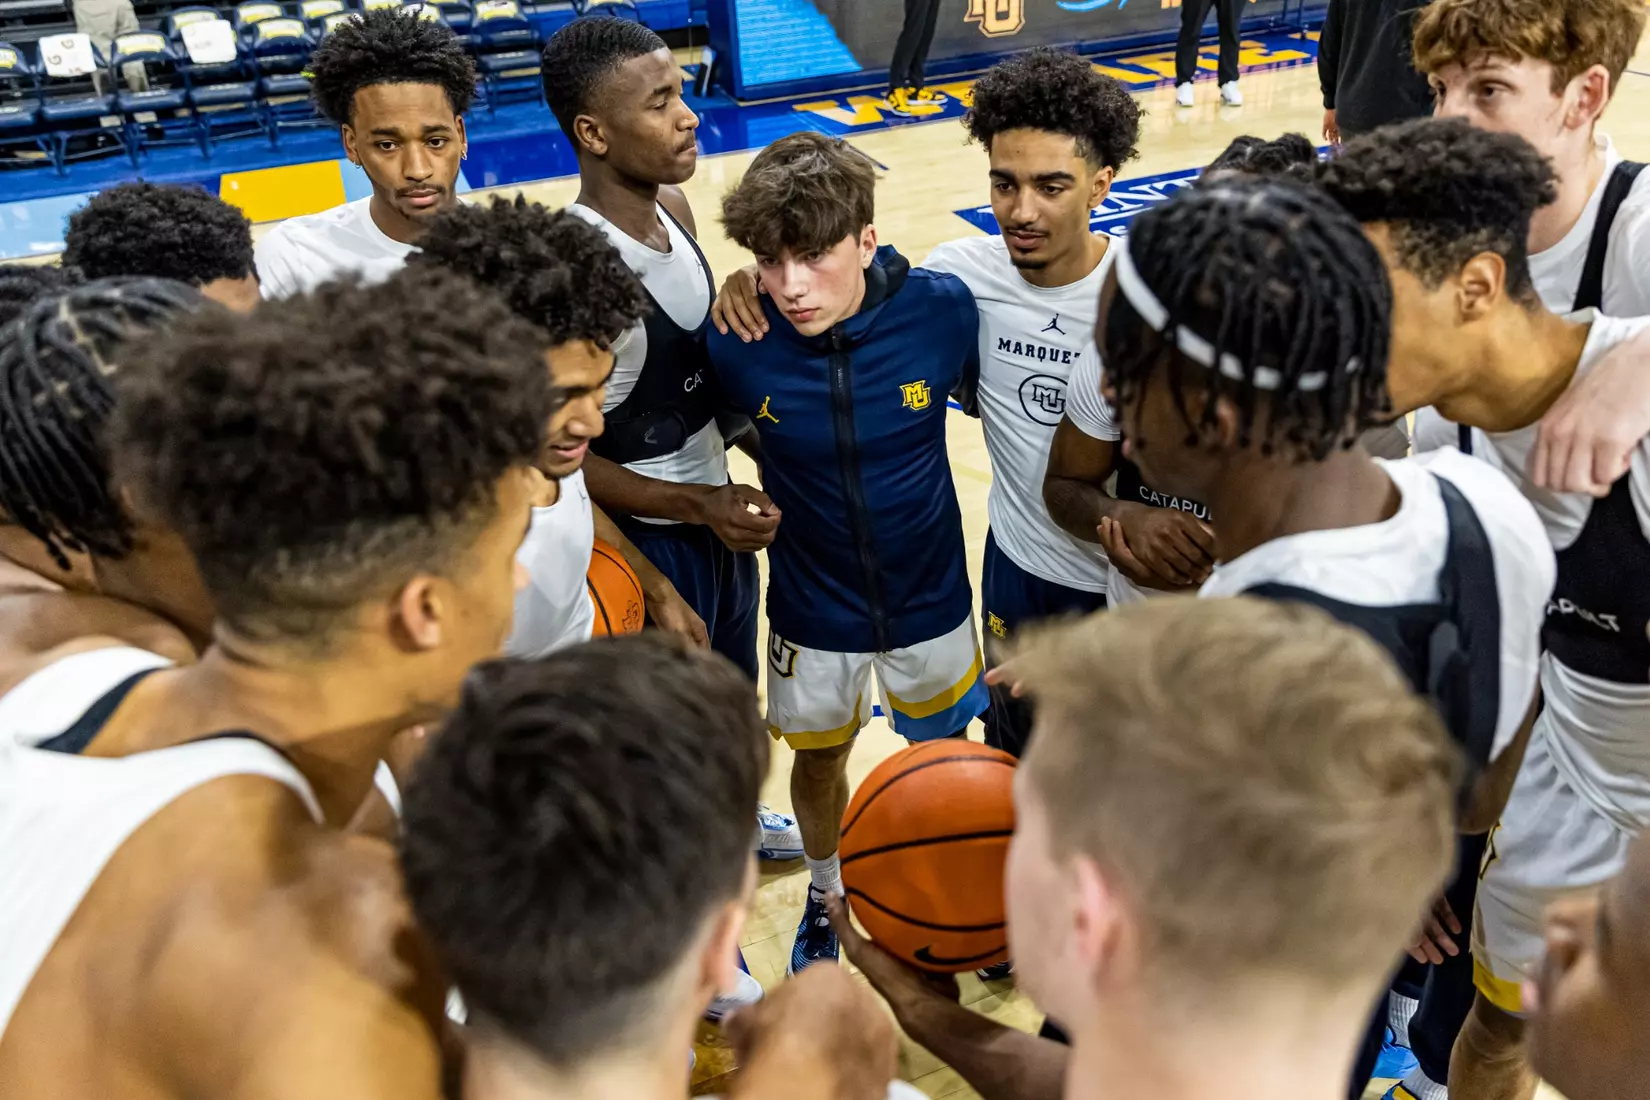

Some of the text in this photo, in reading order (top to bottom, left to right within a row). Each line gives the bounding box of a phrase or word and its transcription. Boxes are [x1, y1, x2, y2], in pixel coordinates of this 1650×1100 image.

[684, 369, 703, 392] CA
[899, 380, 931, 410] MU
[1032, 383, 1066, 415] MU
